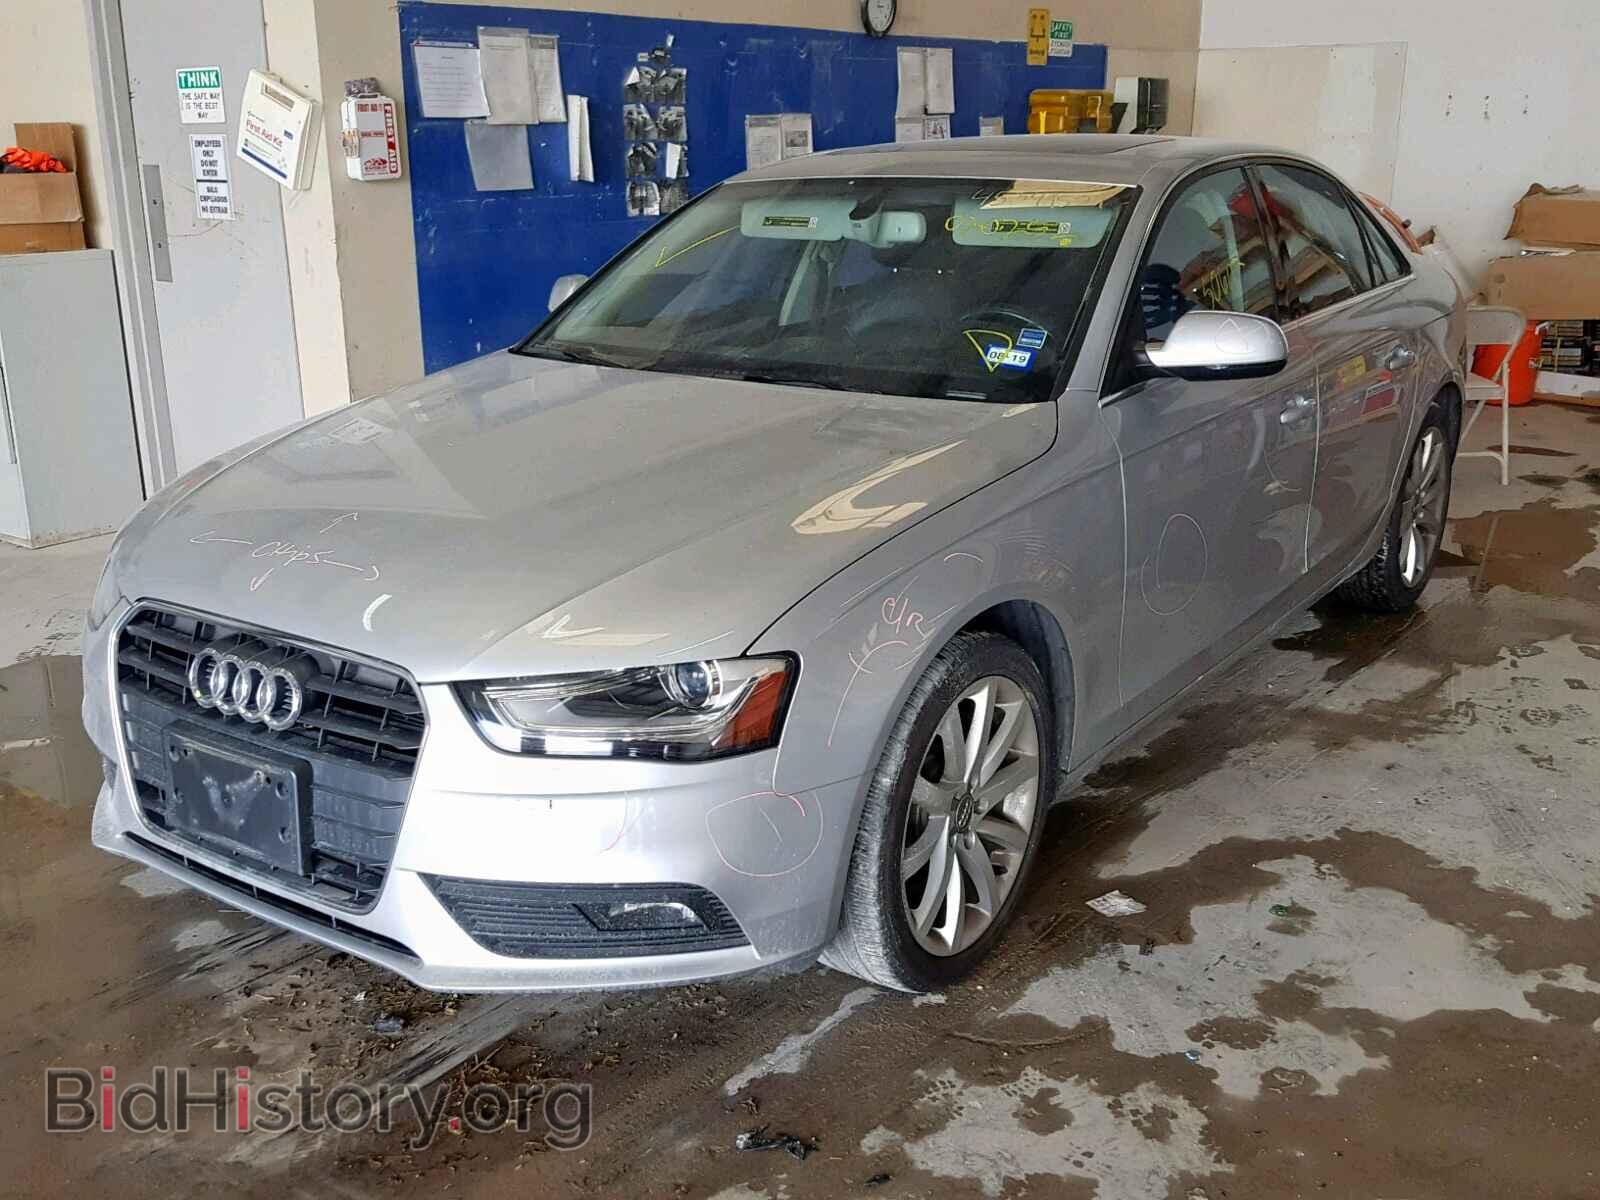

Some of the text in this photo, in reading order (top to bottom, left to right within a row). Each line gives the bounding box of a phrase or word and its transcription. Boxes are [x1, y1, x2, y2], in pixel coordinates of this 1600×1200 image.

[179, 71, 218, 88] THINK
[182, 92, 192, 100] THE
[193, 102, 203, 110] THE
[205, 102, 218, 110] BEST
[246, 119, 261, 134] First
[194, 139, 221, 148] EMPLOYEES
[384, 104, 398, 173] FIRST AID
